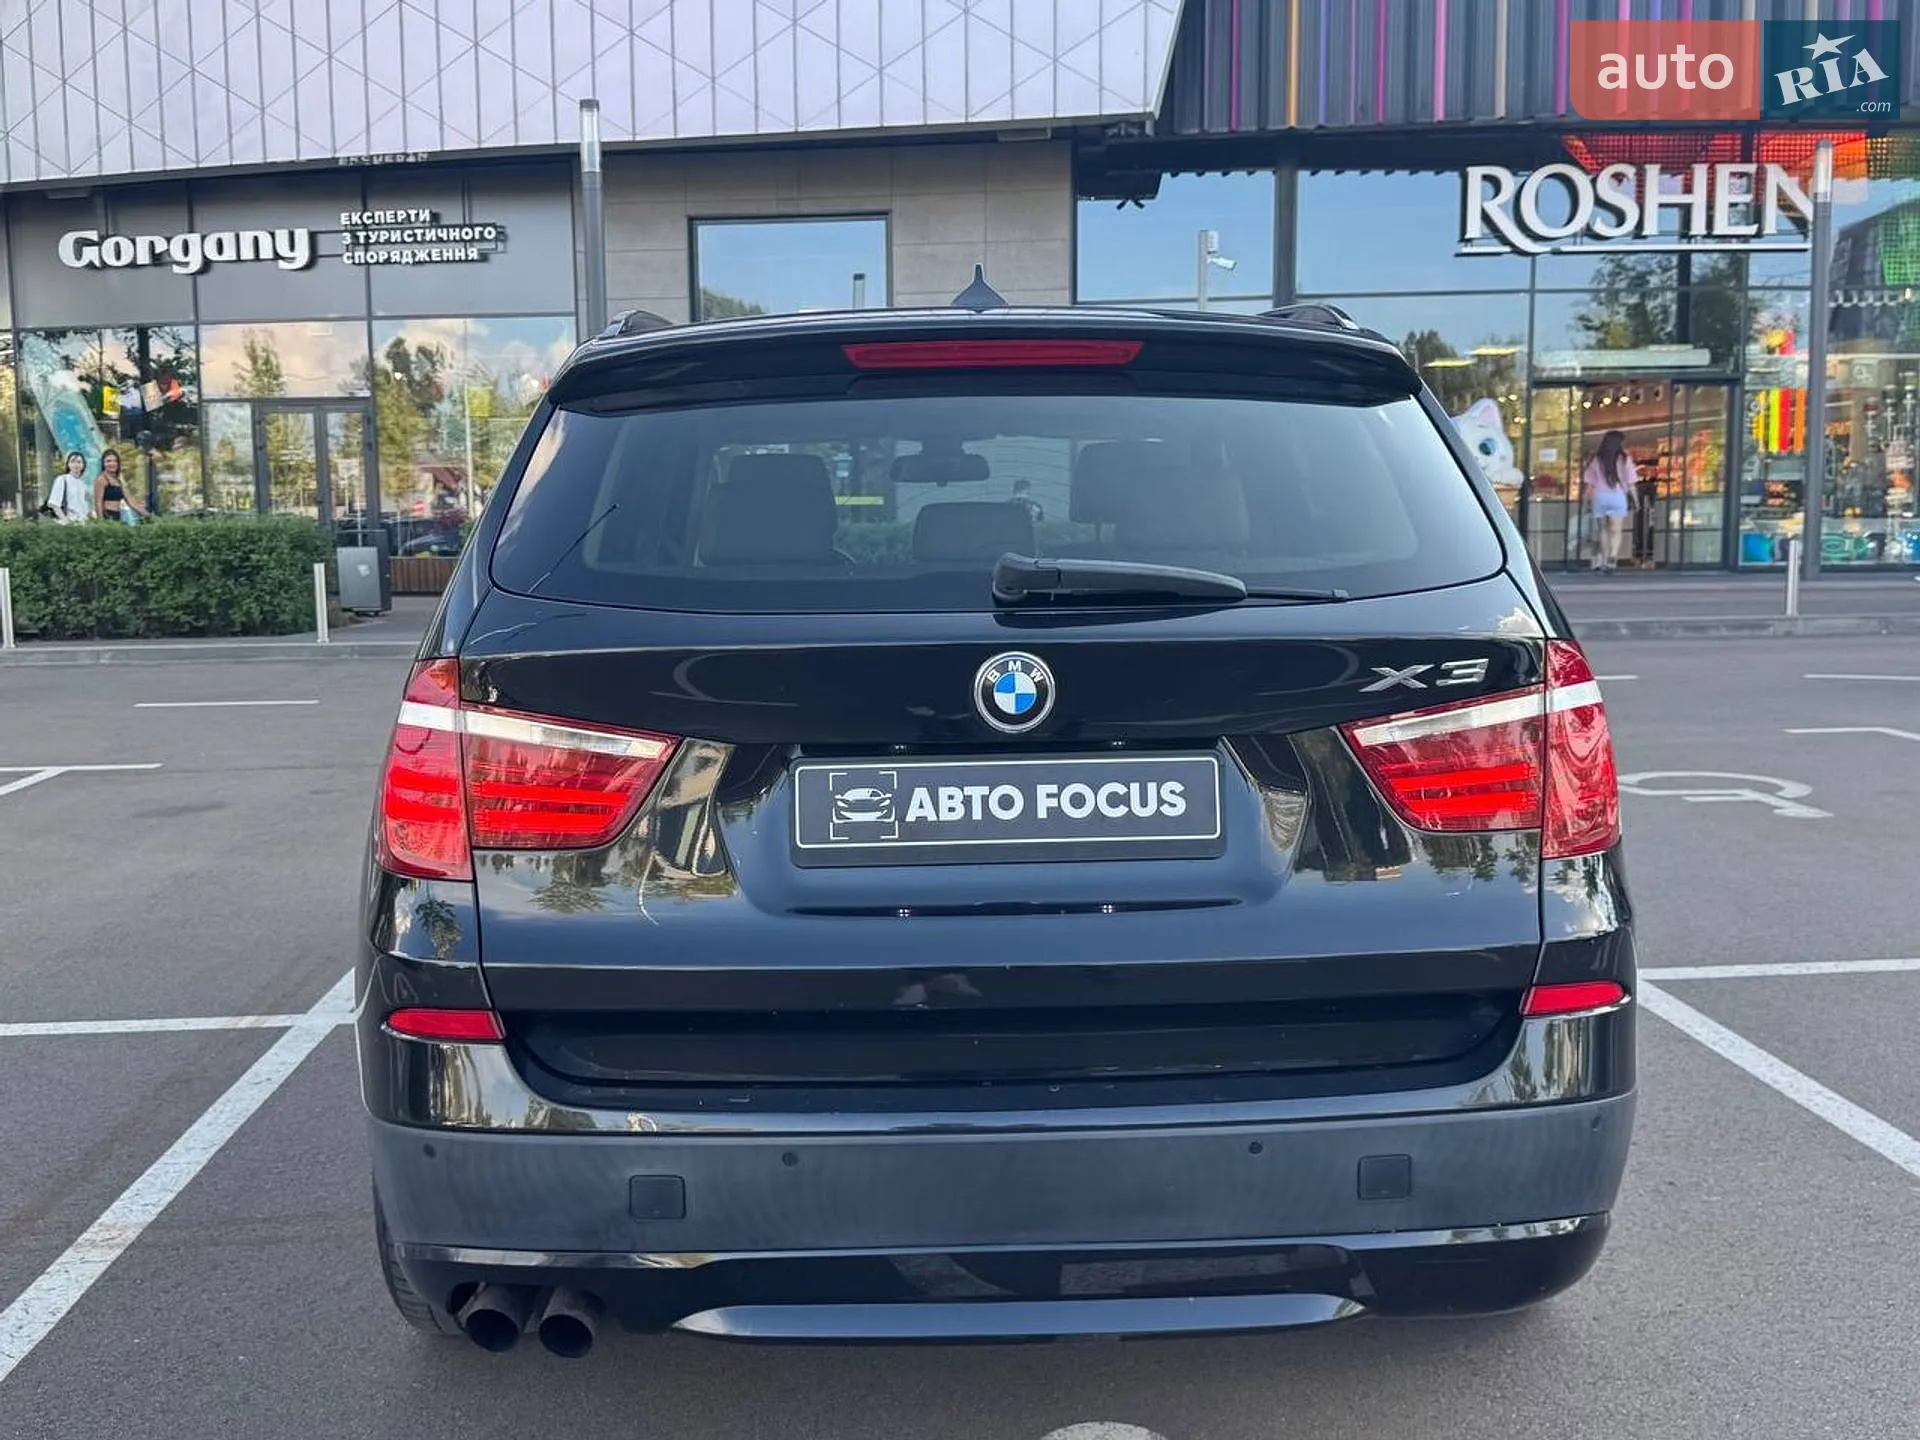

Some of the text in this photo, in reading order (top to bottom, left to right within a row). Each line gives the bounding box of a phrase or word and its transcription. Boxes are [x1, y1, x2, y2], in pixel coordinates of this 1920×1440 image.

[340, 208, 432, 225] ЕКСПЕРТИ
[1464, 162, 1814, 253] ROSHEN
[355, 226, 497, 244] ТУРИСТИЧНОГО
[57, 227, 309, 275] Gorgany
[342, 247, 479, 265] СПОРЯДЖЕННЯ
[986, 660, 1045, 684] BMW
[1358, 658, 1489, 693] X3
[1036, 780, 1187, 819] FOCUS
